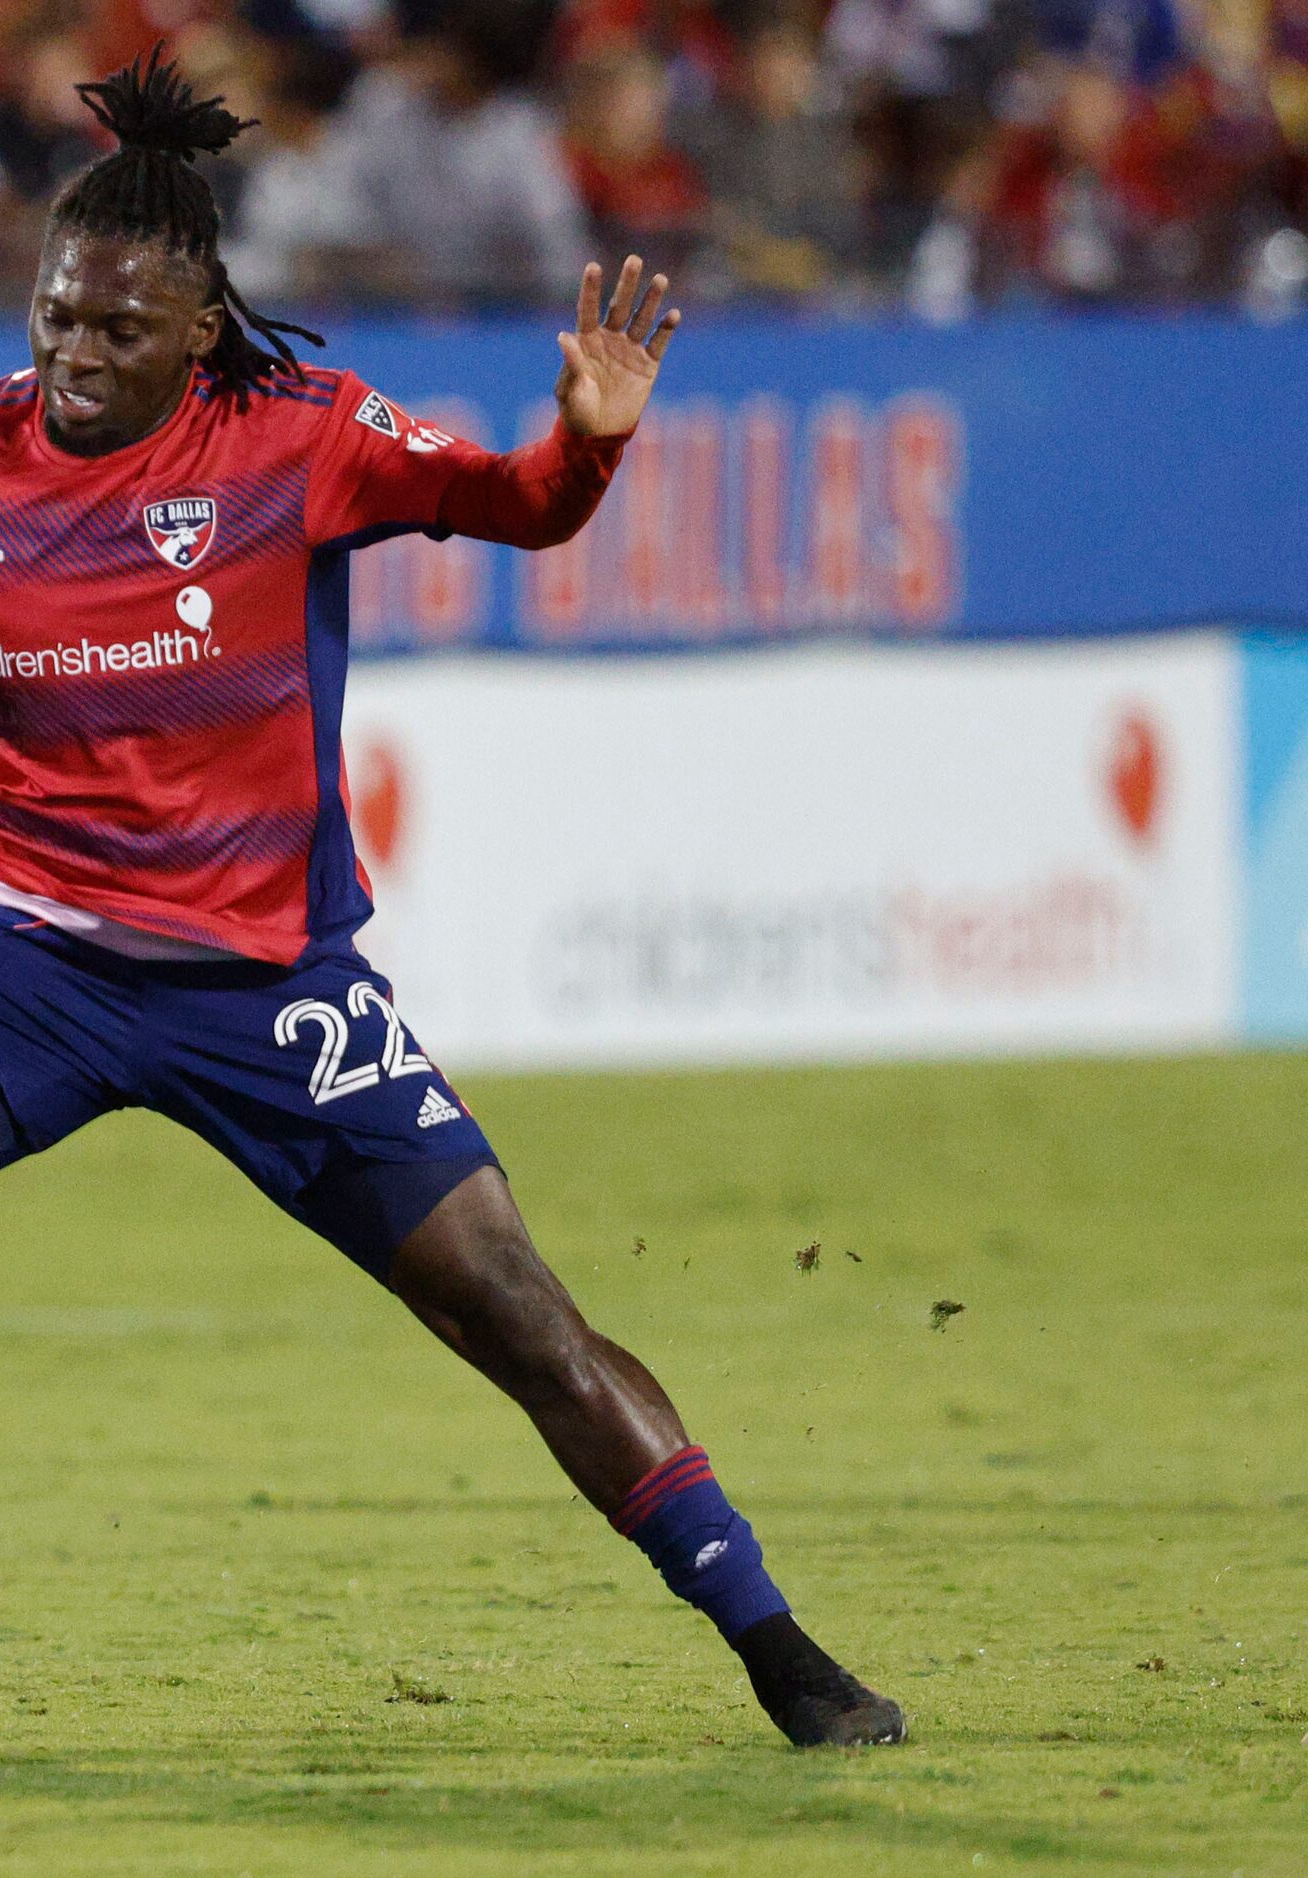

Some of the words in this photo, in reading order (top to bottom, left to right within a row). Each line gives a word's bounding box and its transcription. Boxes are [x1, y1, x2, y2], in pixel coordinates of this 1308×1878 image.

[361, 398, 382, 421] MLS
[149, 506, 165, 526] FC
[167, 501, 211, 521] DALLAS
[273, 981, 433, 1105] 22
